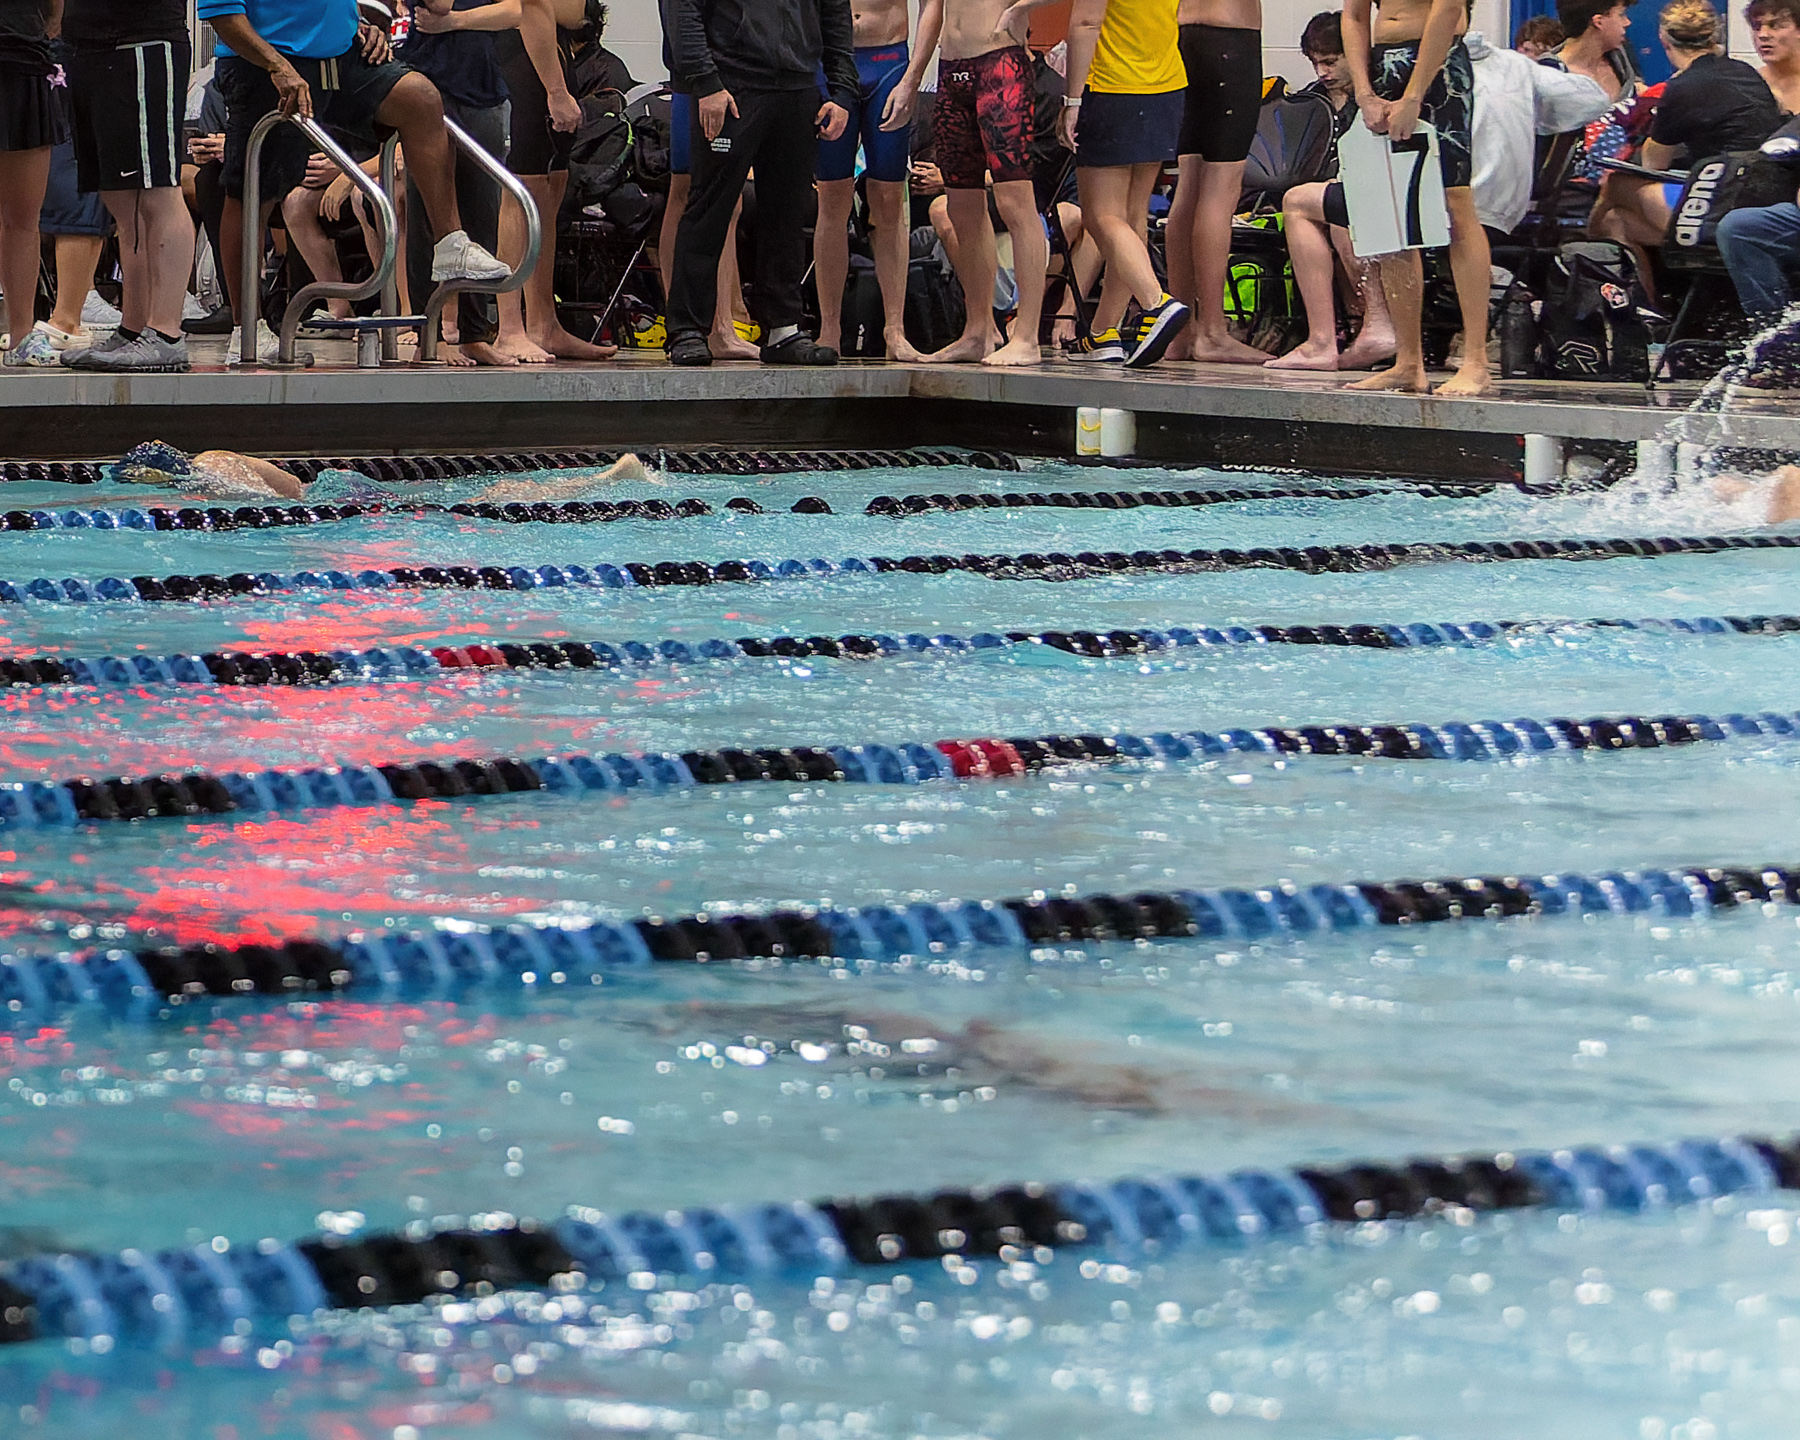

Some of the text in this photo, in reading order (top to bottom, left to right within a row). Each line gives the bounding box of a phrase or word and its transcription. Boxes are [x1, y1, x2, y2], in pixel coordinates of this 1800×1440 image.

[951, 71, 970, 82] TYR
[1389, 131, 1430, 246] 7
[1675, 162, 1726, 247] arena
